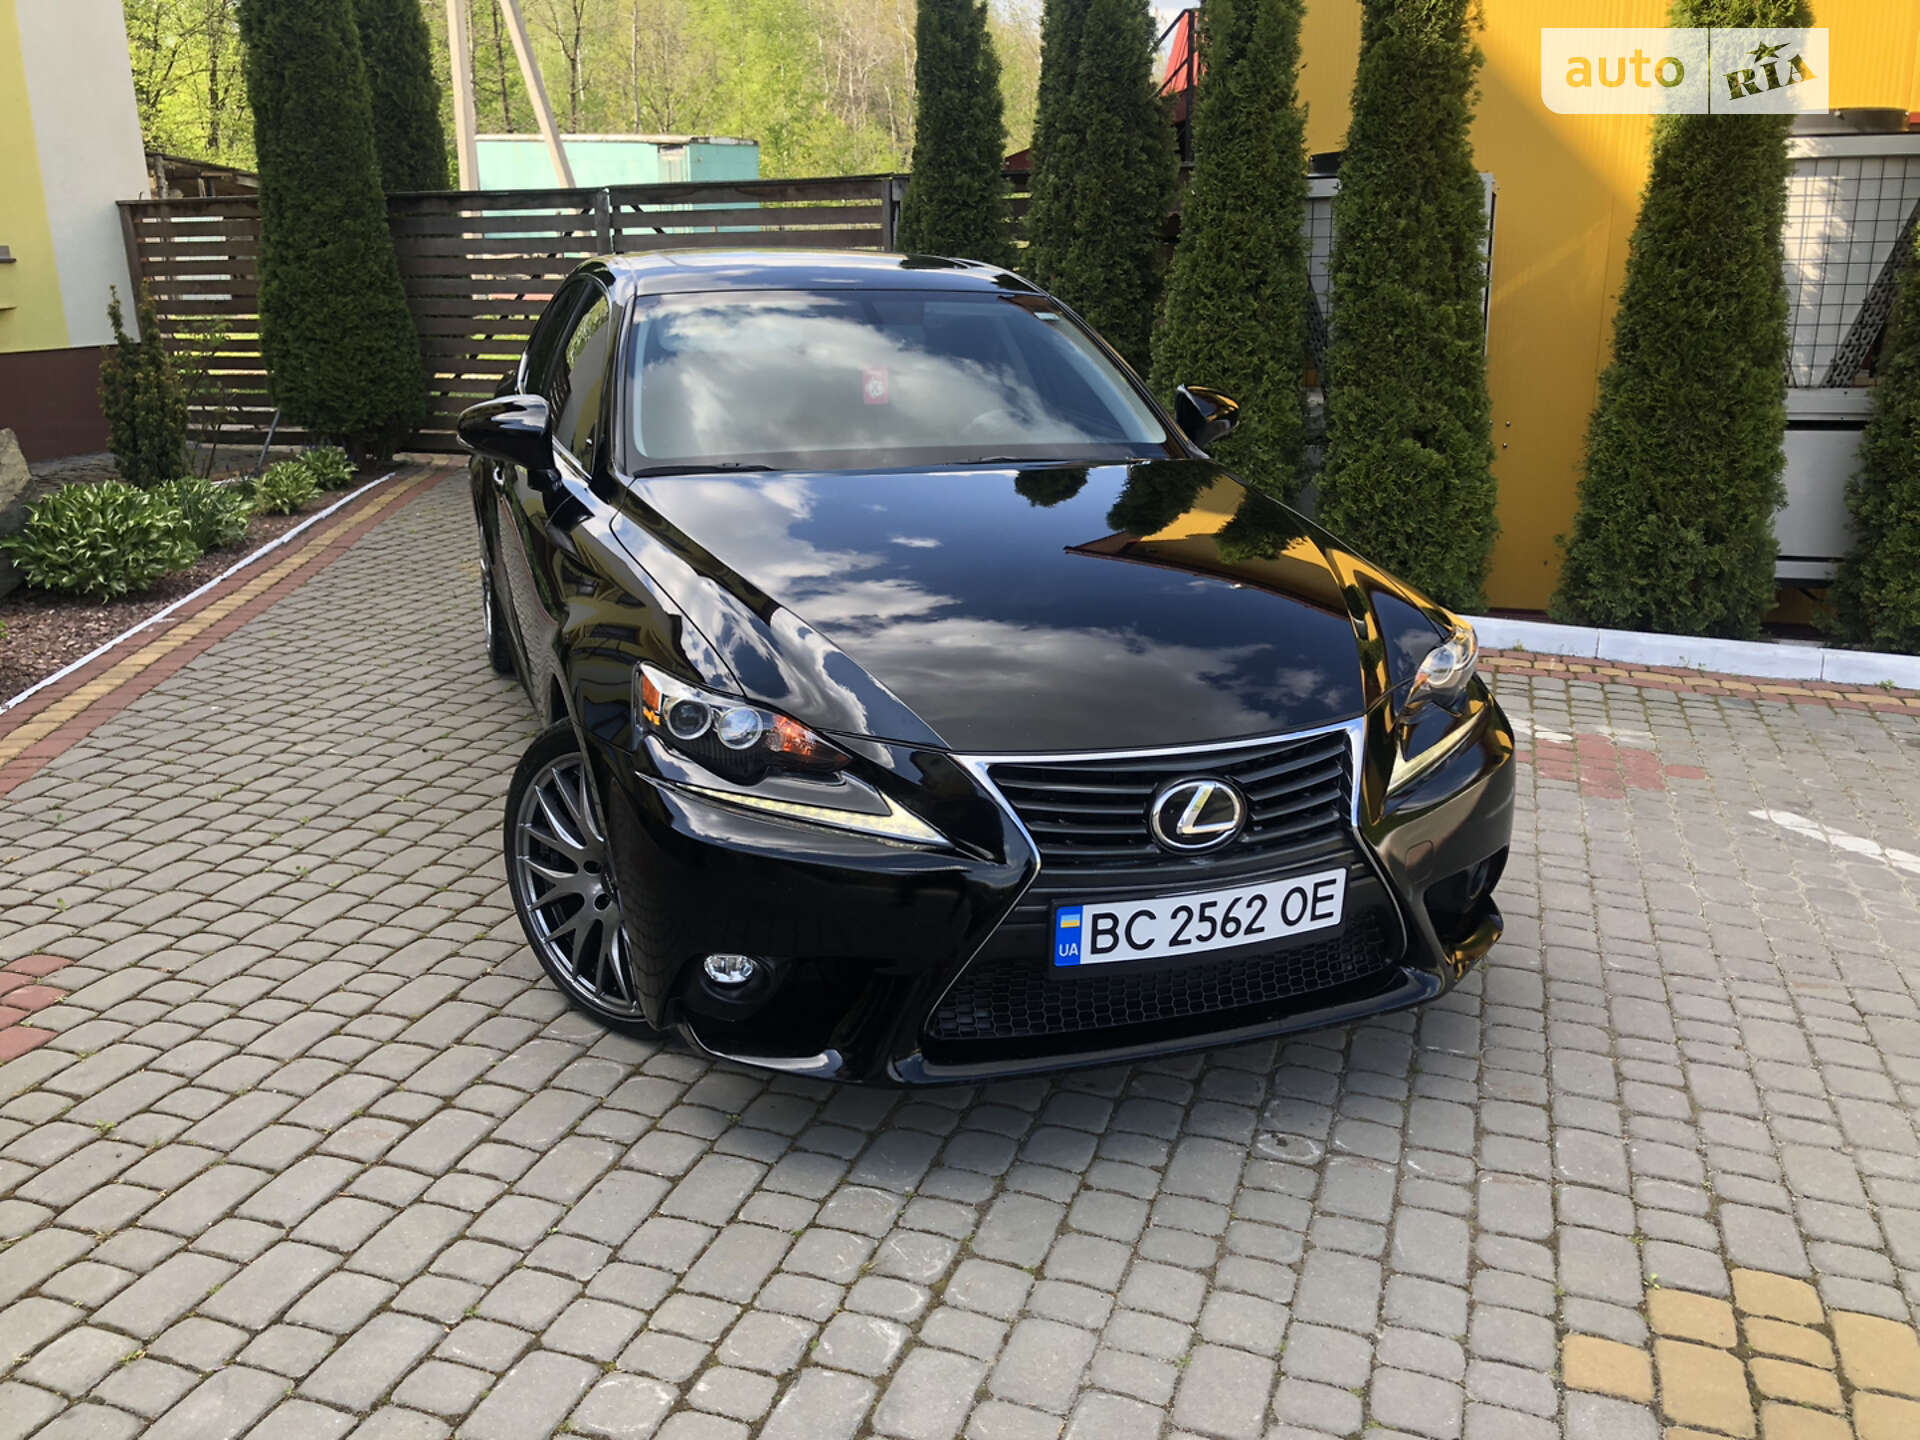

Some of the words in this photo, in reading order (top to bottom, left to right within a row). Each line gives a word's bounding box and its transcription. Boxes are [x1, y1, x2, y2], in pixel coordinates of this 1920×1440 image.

[1090, 910, 1157, 955] BC
[1168, 894, 1267, 947] 2562
[1281, 878, 1337, 927] OE
[1058, 943, 1079, 957] UA
